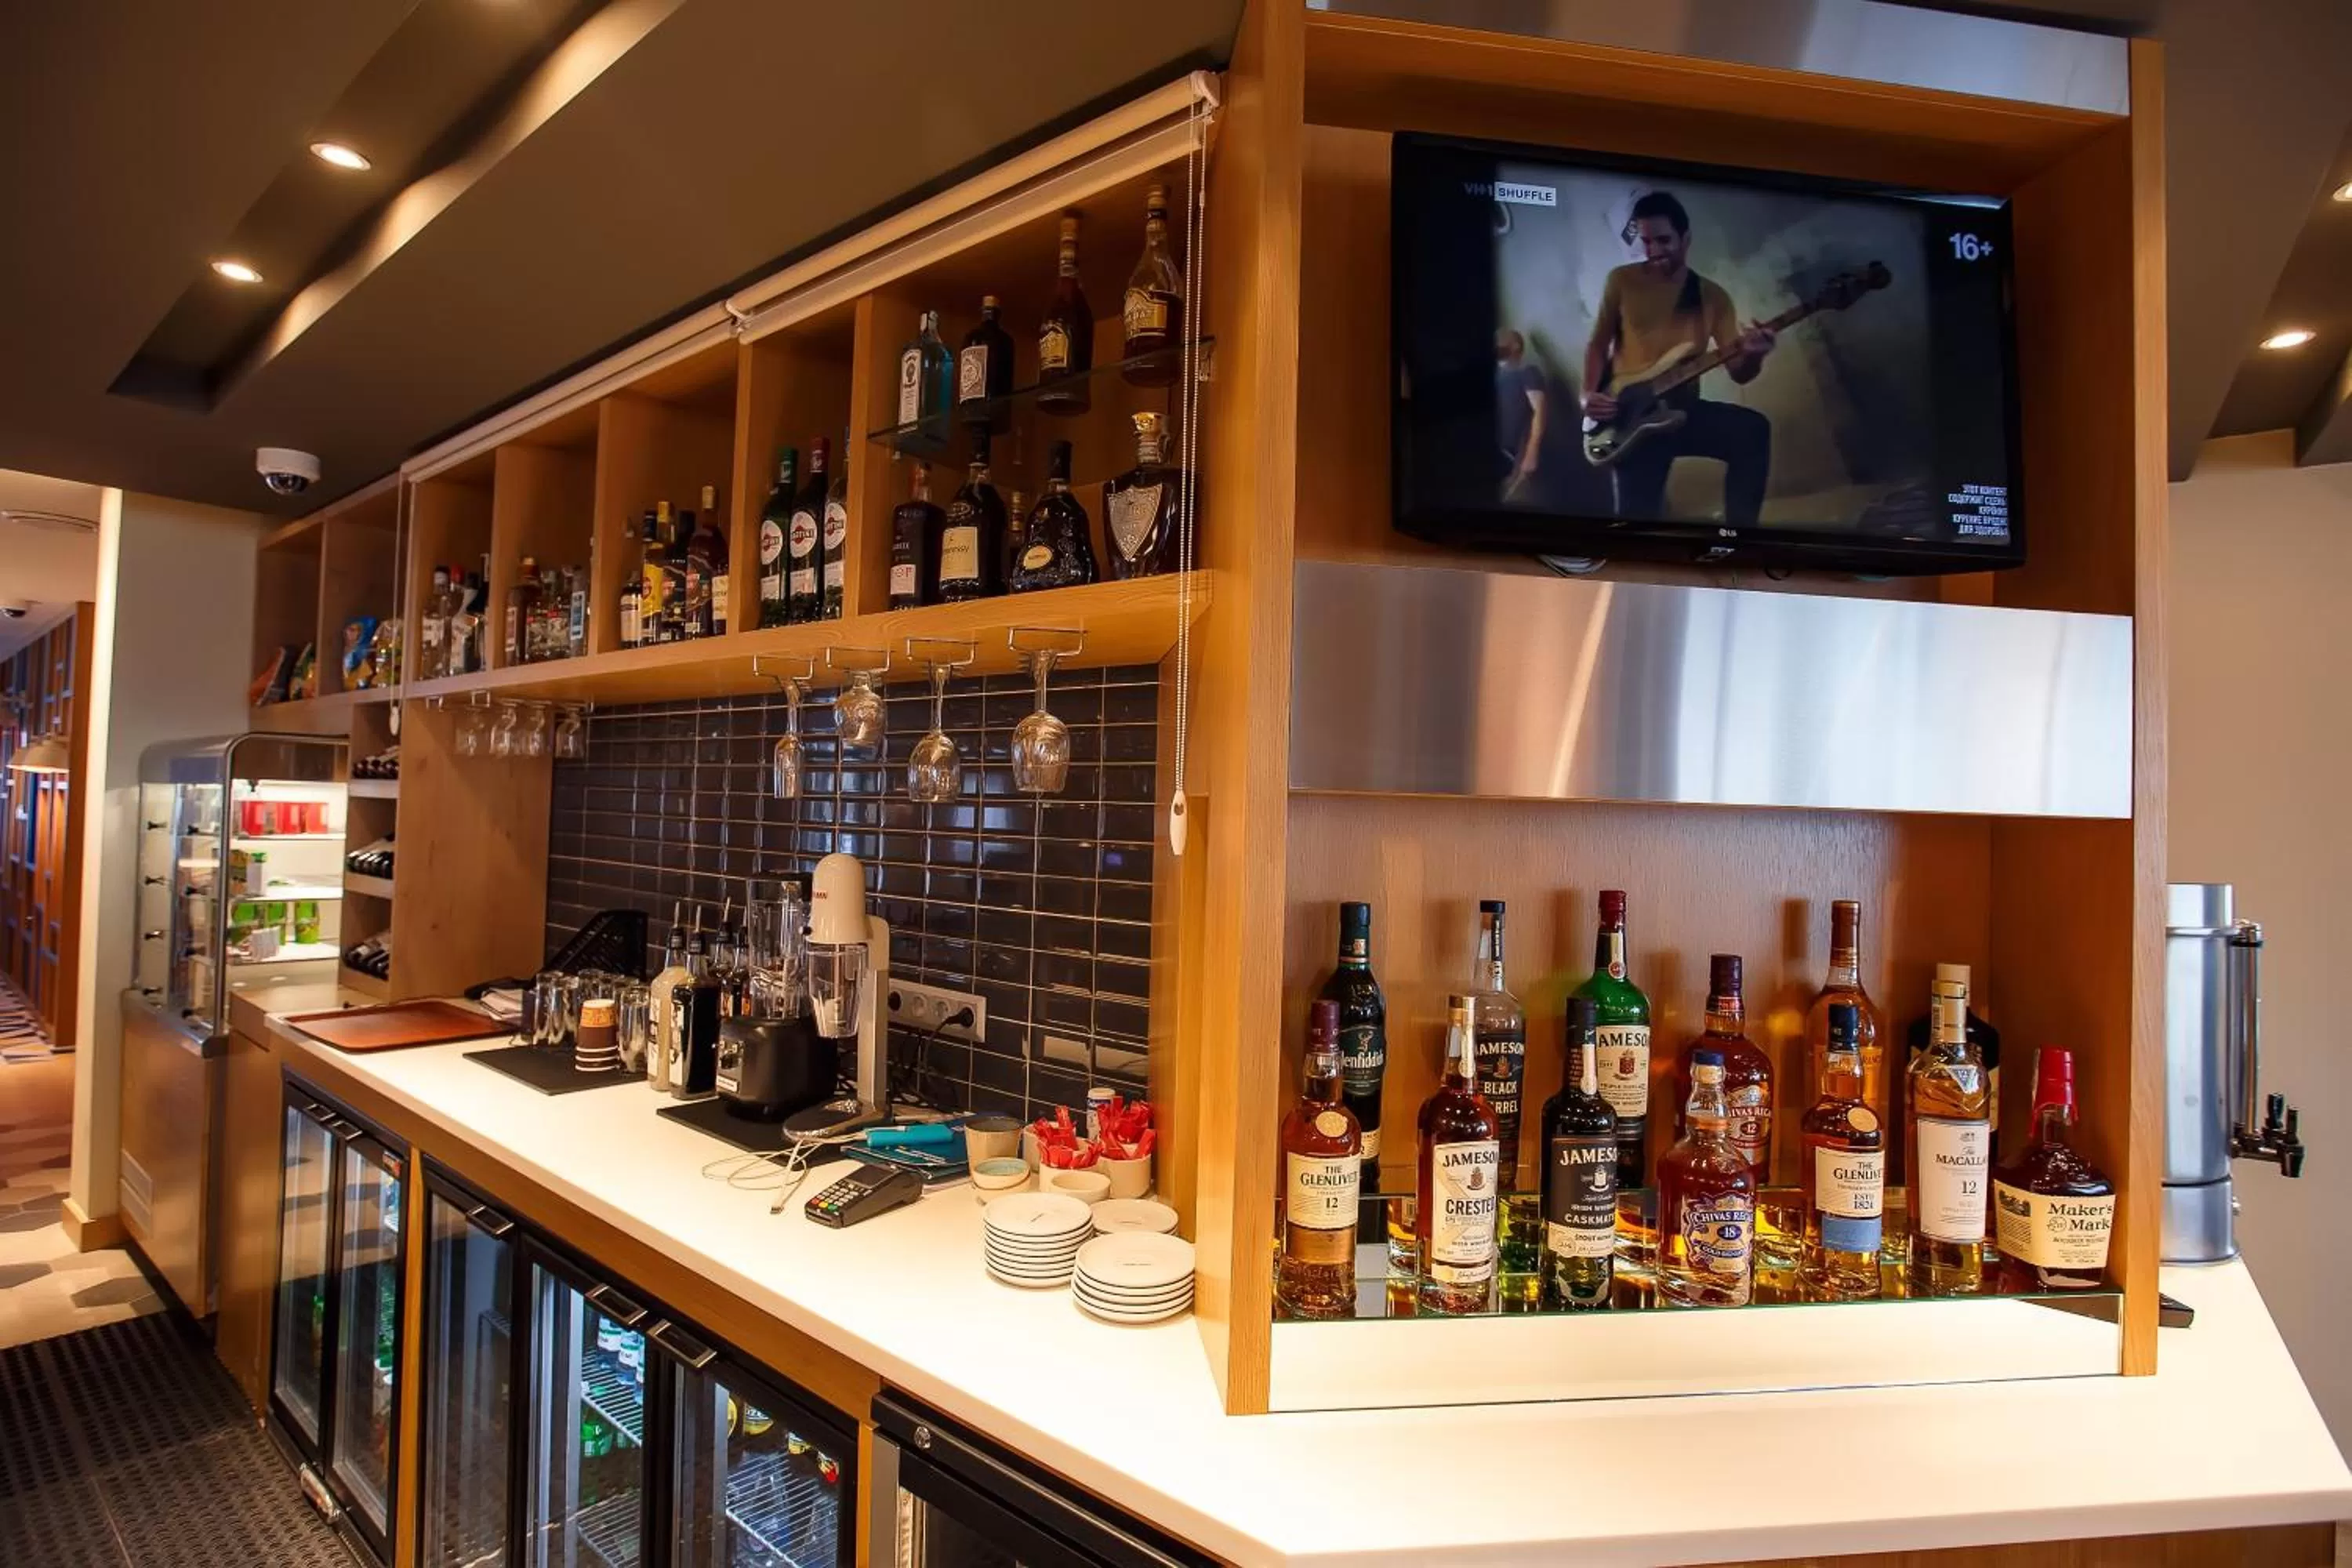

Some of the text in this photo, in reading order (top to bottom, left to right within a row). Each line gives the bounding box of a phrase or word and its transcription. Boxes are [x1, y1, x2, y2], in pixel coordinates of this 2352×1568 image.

[1498, 187, 1553, 201] SHUFFLE
[1948, 232, 1994, 260] 16+
[1599, 1033, 1646, 1047] AMESO
[1475, 1042, 1525, 1055] AMESON
[1484, 1081, 1517, 1094] BLACK
[1857, 1161, 1873, 1170] THE
[1936, 1153, 1987, 1167] MACALLA
[1326, 1165, 1342, 1174] THE
[1962, 1180, 1976, 1194] 12
[1326, 1197, 1338, 1208] 12
[2048, 1203, 2113, 1216] Maker's
[2069, 1218, 2110, 1232] Mark
[1724, 1226, 1736, 1238] 18
